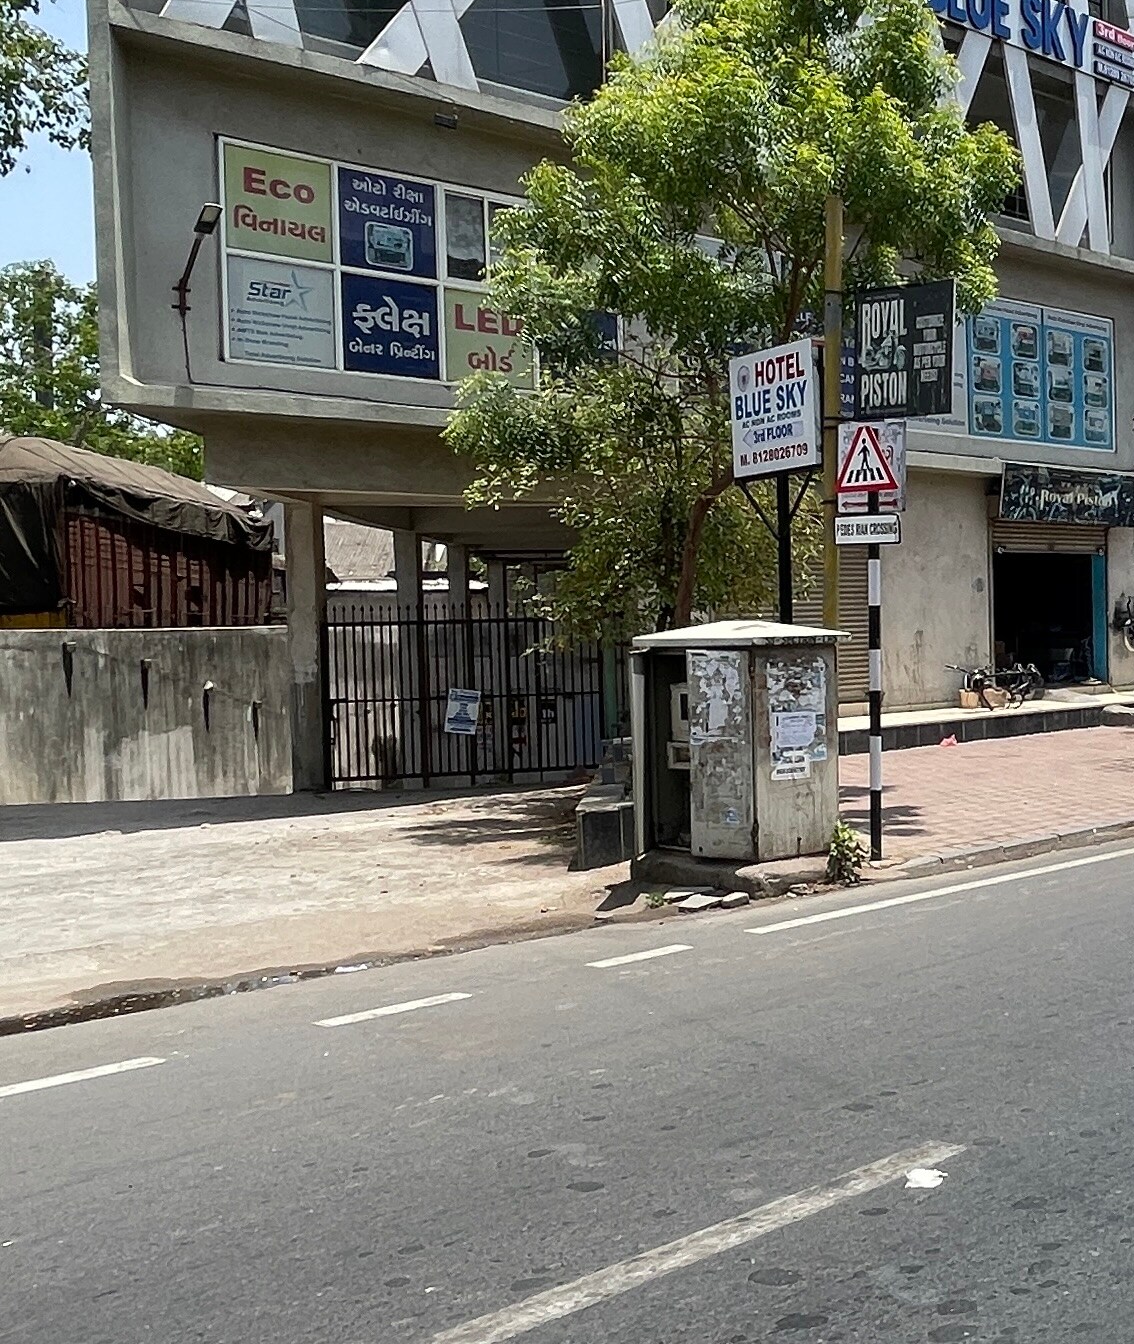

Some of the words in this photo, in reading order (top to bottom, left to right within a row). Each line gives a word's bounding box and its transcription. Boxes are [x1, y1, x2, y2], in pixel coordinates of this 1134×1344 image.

[1096, 22, 1116, 41] 3rd
[243, 166, 315, 204] Eco
[352, 176, 387, 196] ઓટો
[392, 183, 424, 204] રીક્ષા
[233, 204, 326, 244] વિનાયલ
[454, 303, 525, 338] LED
[861, 298, 908, 353] ROYAL
[348, 337, 384, 356] બેનર
[754, 351, 806, 388] HOTEL
[735, 388, 772, 421] BLUE
[775, 379, 807, 411] SKY
[860, 370, 908, 408] PISTON
[753, 430, 766, 444] 3rd
[766, 423, 794, 441] FLOOR
[1040, 488, 1075, 511] Royal
